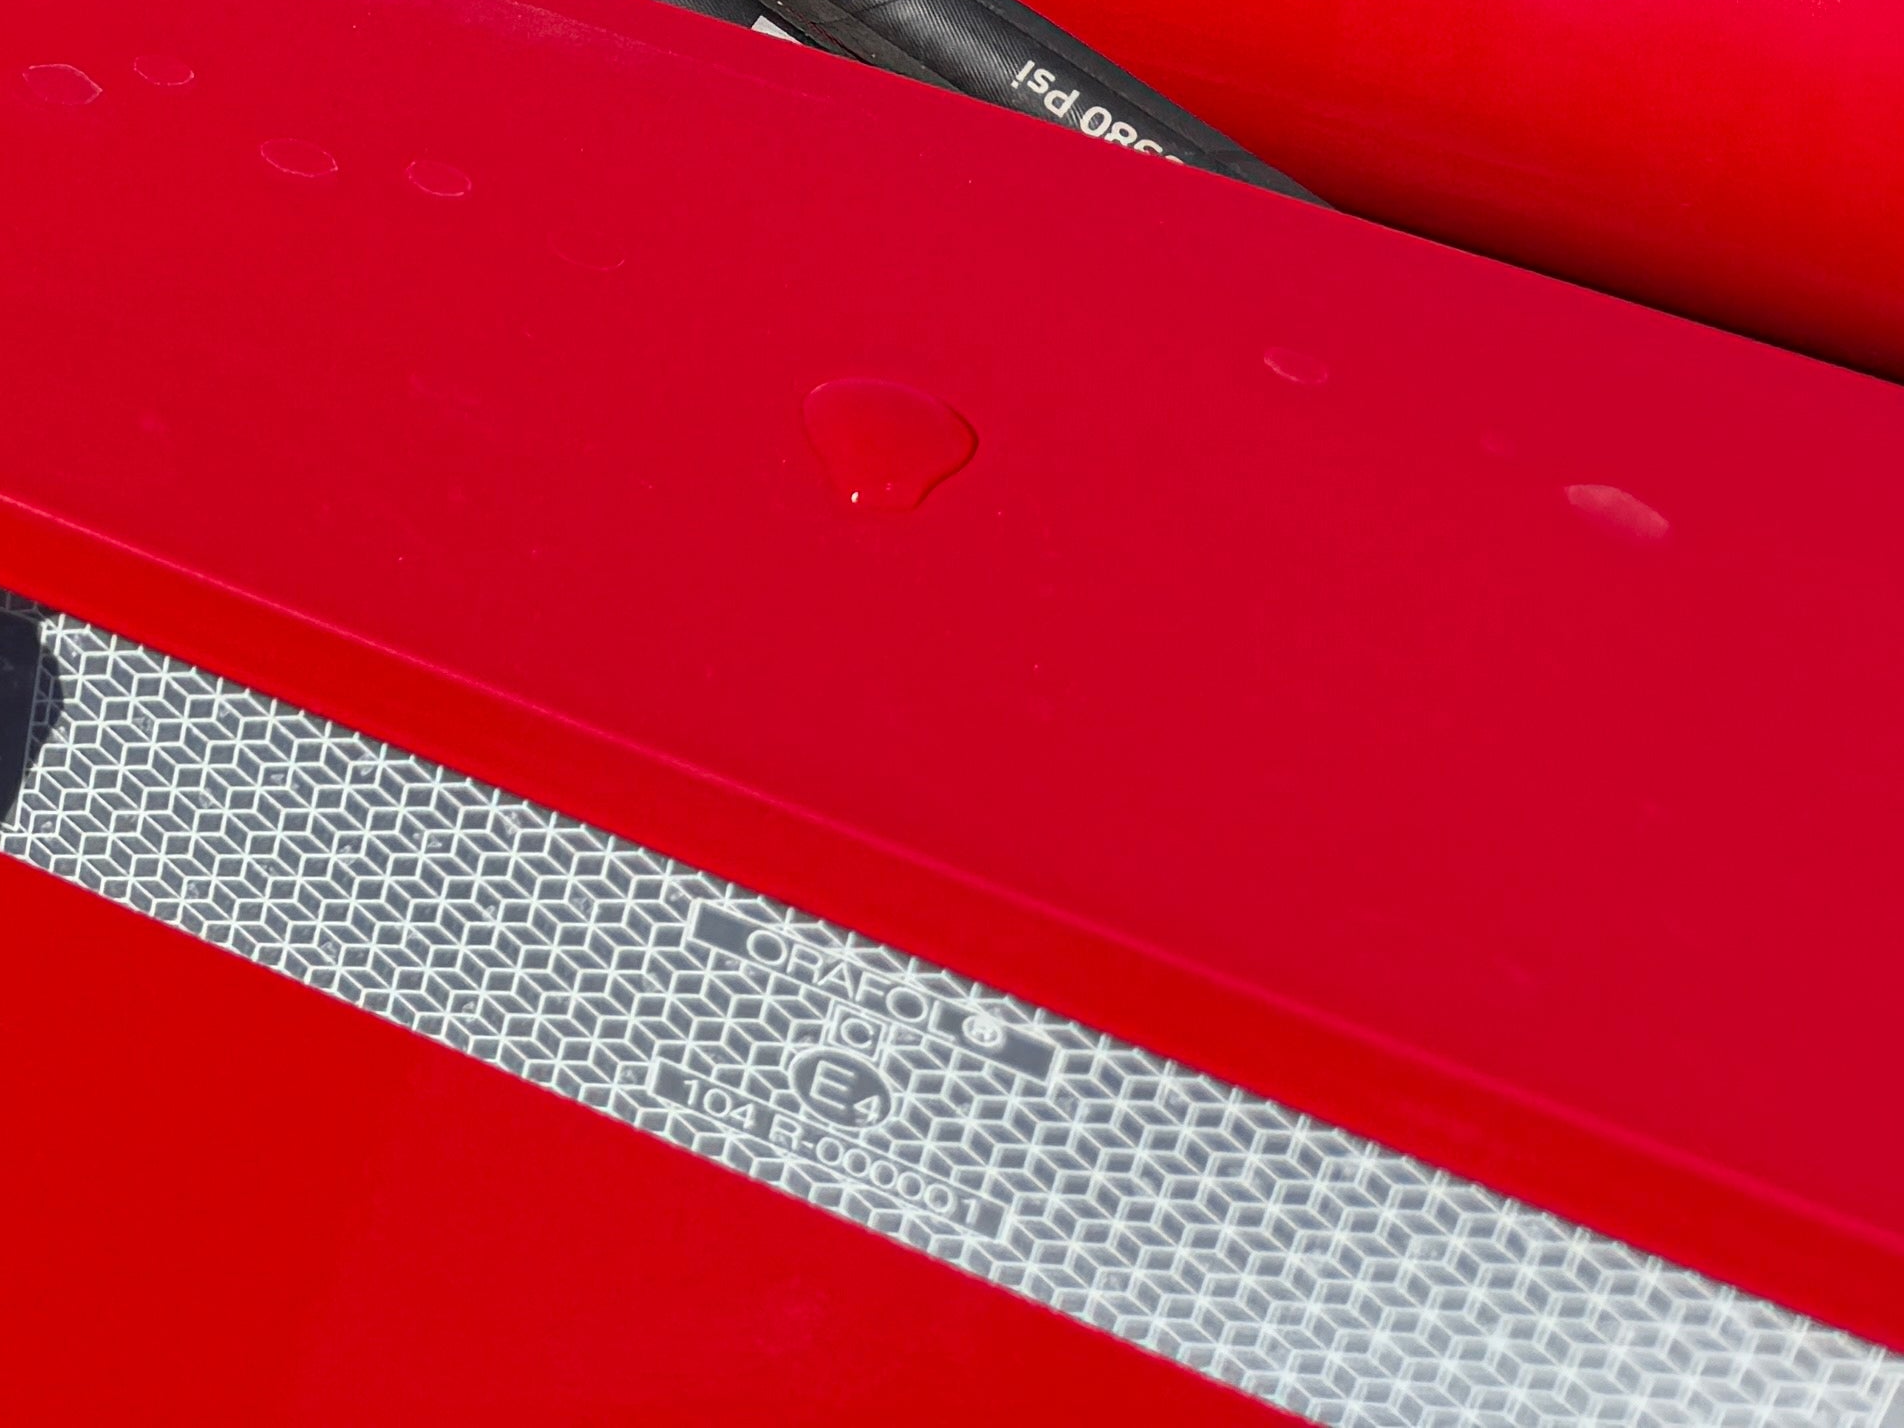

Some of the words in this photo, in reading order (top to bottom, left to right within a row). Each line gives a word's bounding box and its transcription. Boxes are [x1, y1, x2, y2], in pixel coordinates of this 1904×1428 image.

[1079, 105, 1185, 166] 80
[682, 1079, 756, 1129] 104
[769, 1113, 980, 1226] R-000001
